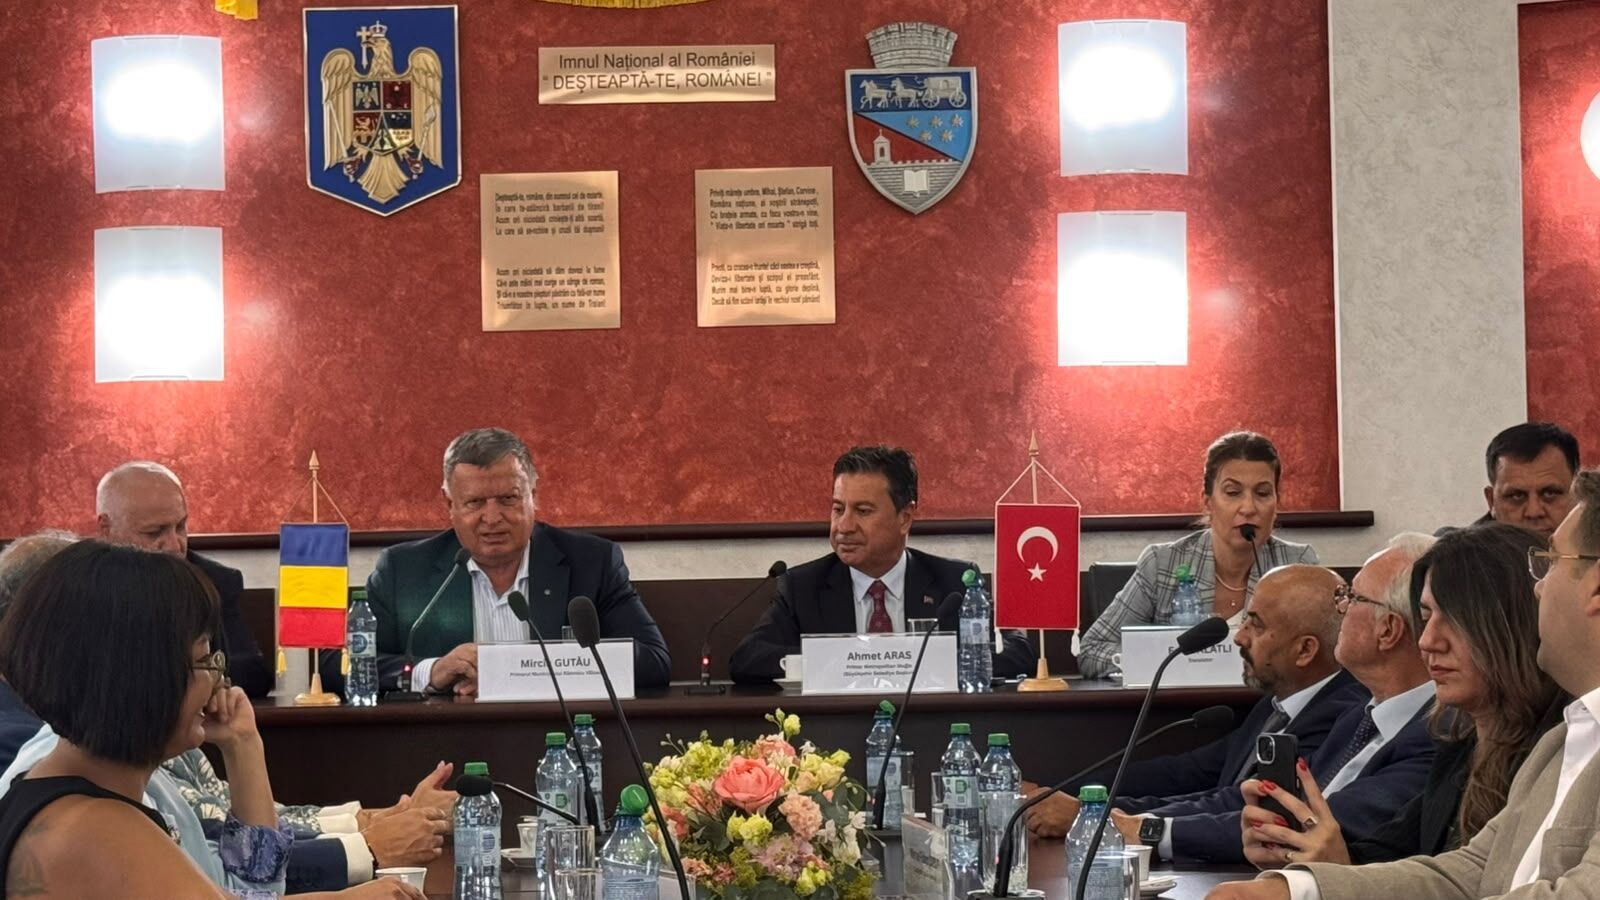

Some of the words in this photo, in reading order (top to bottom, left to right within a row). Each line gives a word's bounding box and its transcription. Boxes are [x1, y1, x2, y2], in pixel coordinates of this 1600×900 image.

[559, 54, 599, 69] Imnul
[603, 53, 664, 72] Național
[669, 53, 681, 68] al
[686, 52, 756, 67] României
[848, 651, 881, 661] Ahmet
[884, 651, 912, 660] ARAS
[521, 659, 552, 668] Mirc
